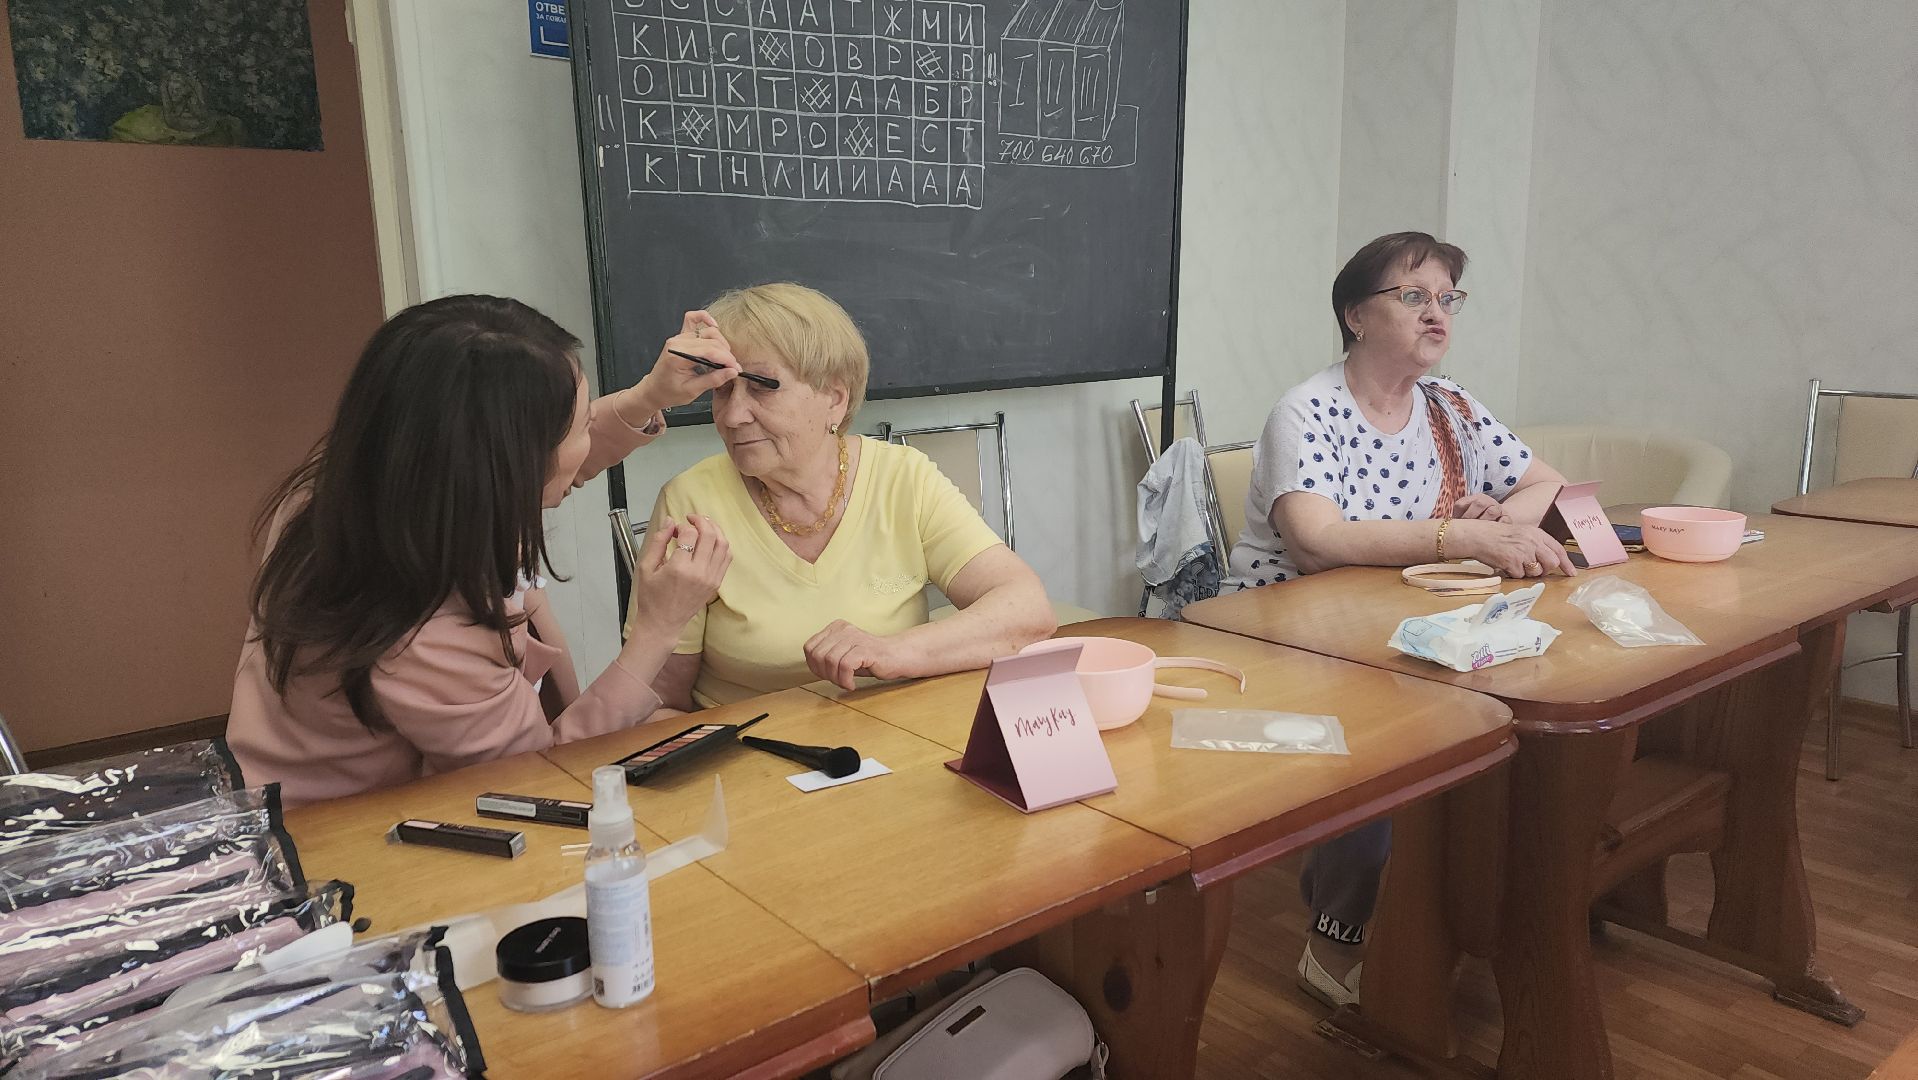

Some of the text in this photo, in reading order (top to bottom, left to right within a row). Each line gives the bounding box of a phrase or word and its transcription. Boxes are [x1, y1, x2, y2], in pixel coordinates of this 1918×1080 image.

[999, 139, 1114, 165] 700 640 670
